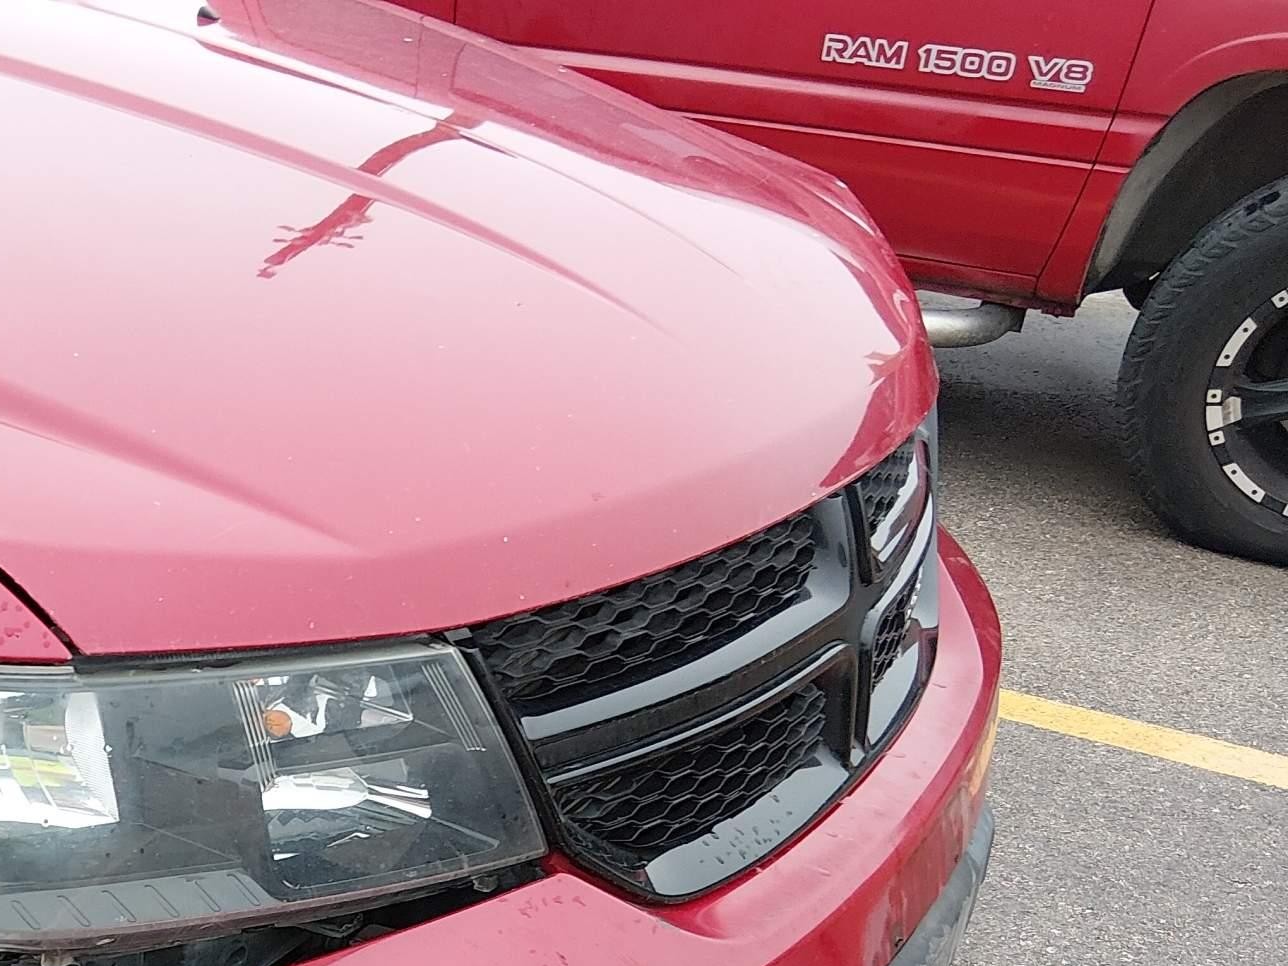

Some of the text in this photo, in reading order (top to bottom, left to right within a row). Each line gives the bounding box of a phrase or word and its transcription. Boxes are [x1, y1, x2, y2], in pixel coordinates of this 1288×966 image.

[821, 33, 1093, 85] RAM 1500 V8
[1032, 80, 1085, 92] MAGNUM
